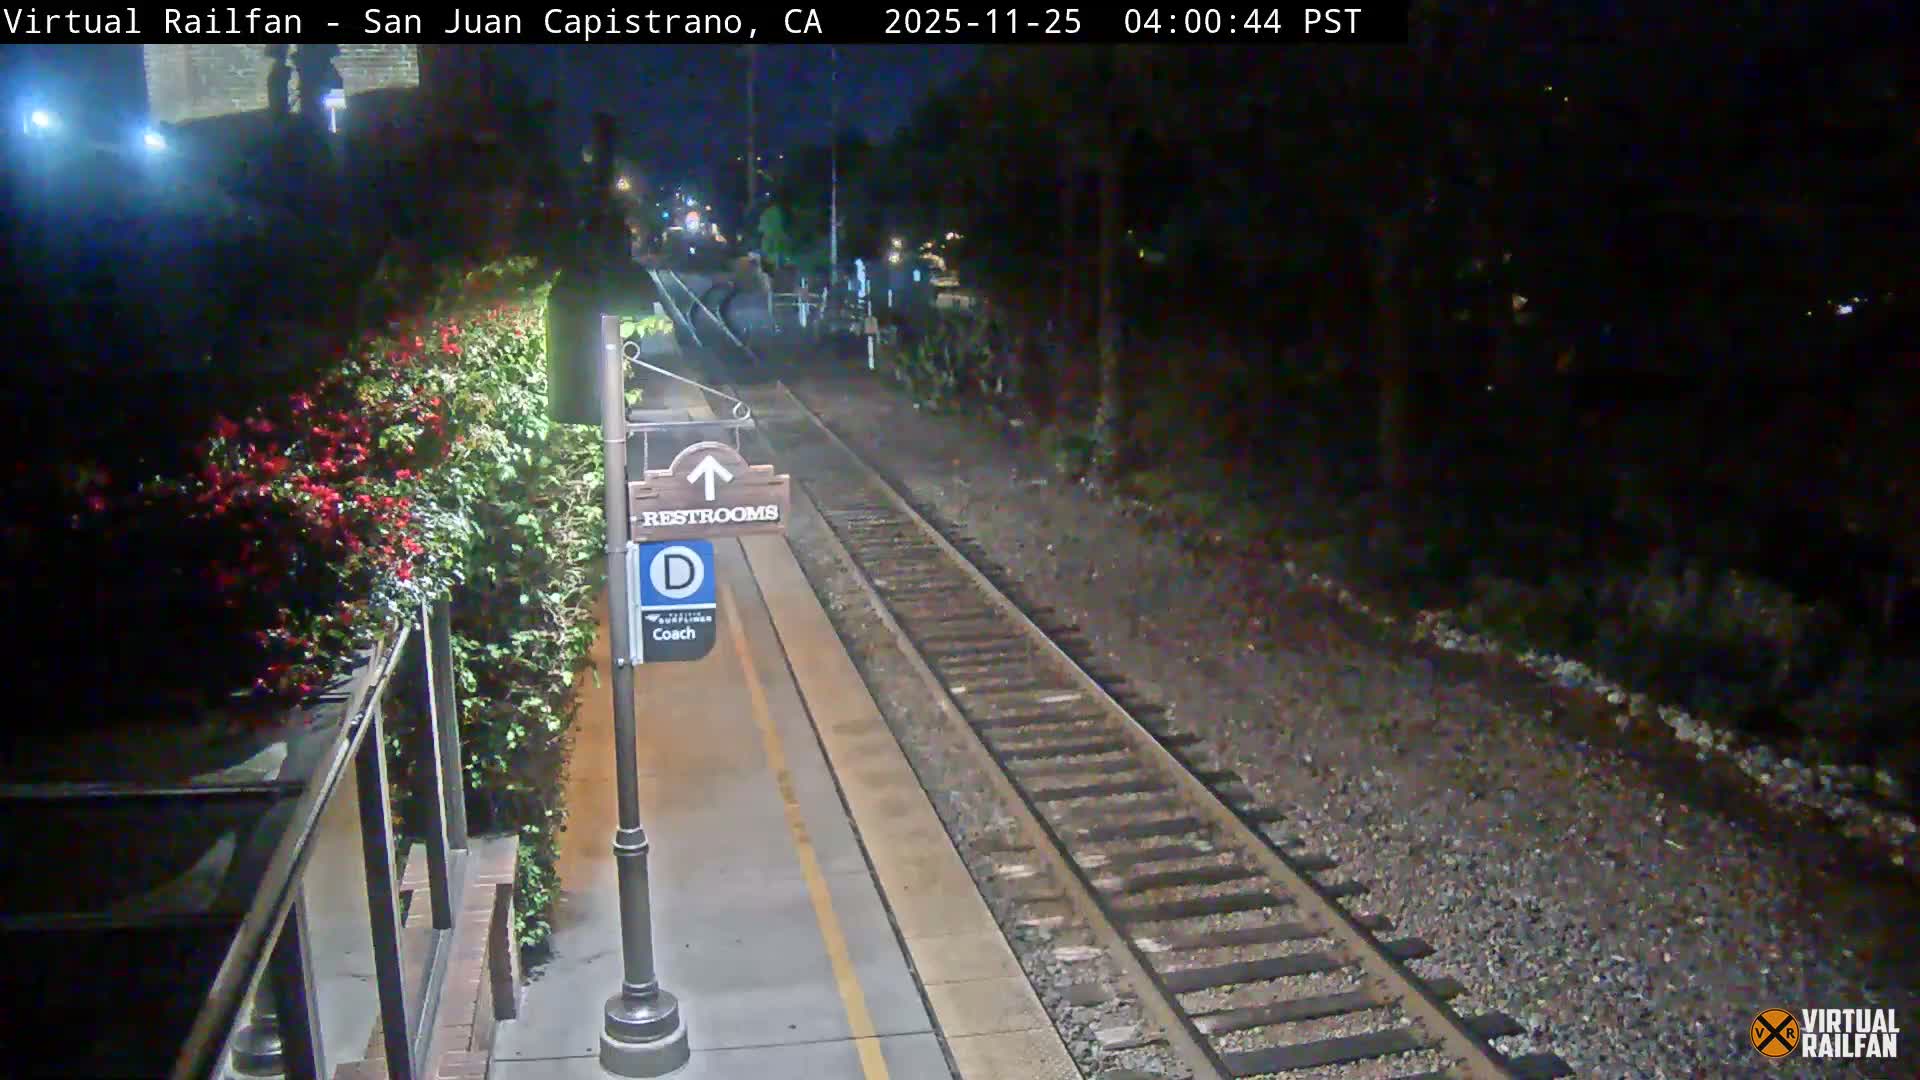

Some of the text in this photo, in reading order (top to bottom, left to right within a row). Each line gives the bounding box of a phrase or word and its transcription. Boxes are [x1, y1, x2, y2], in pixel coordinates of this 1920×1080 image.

[641, 504, 780, 528] RESTROOMS
[664, 554, 696, 590] D
[652, 625, 697, 641] Coach
